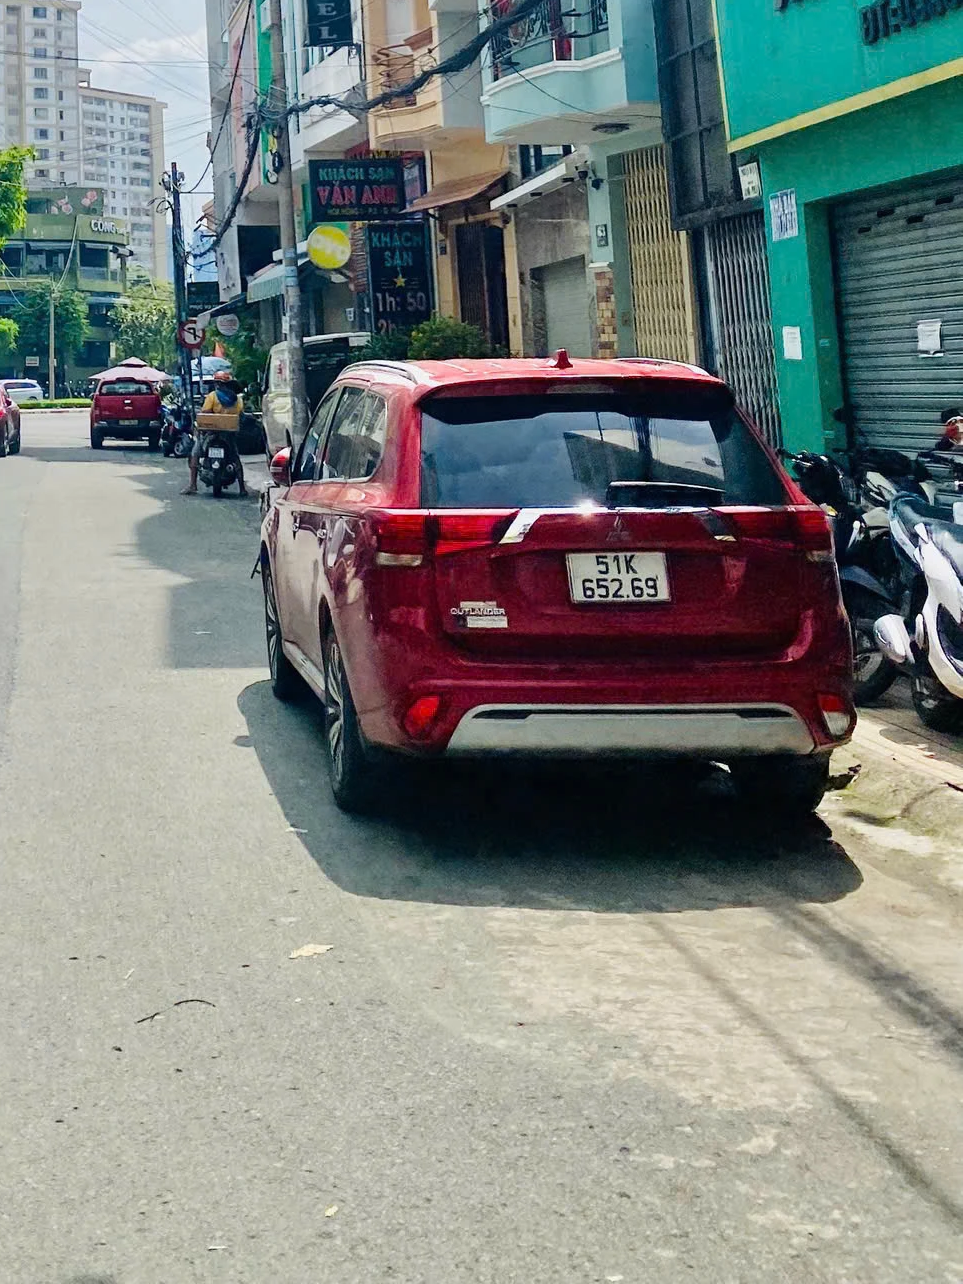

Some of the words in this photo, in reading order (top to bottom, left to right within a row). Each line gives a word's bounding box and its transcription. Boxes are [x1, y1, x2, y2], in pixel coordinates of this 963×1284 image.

[318, 165, 364, 181] KHÁCH
[361, 185, 397, 205] ANH
[596, 554, 637, 575] 51K
[582, 577, 659, 599] 652.69
